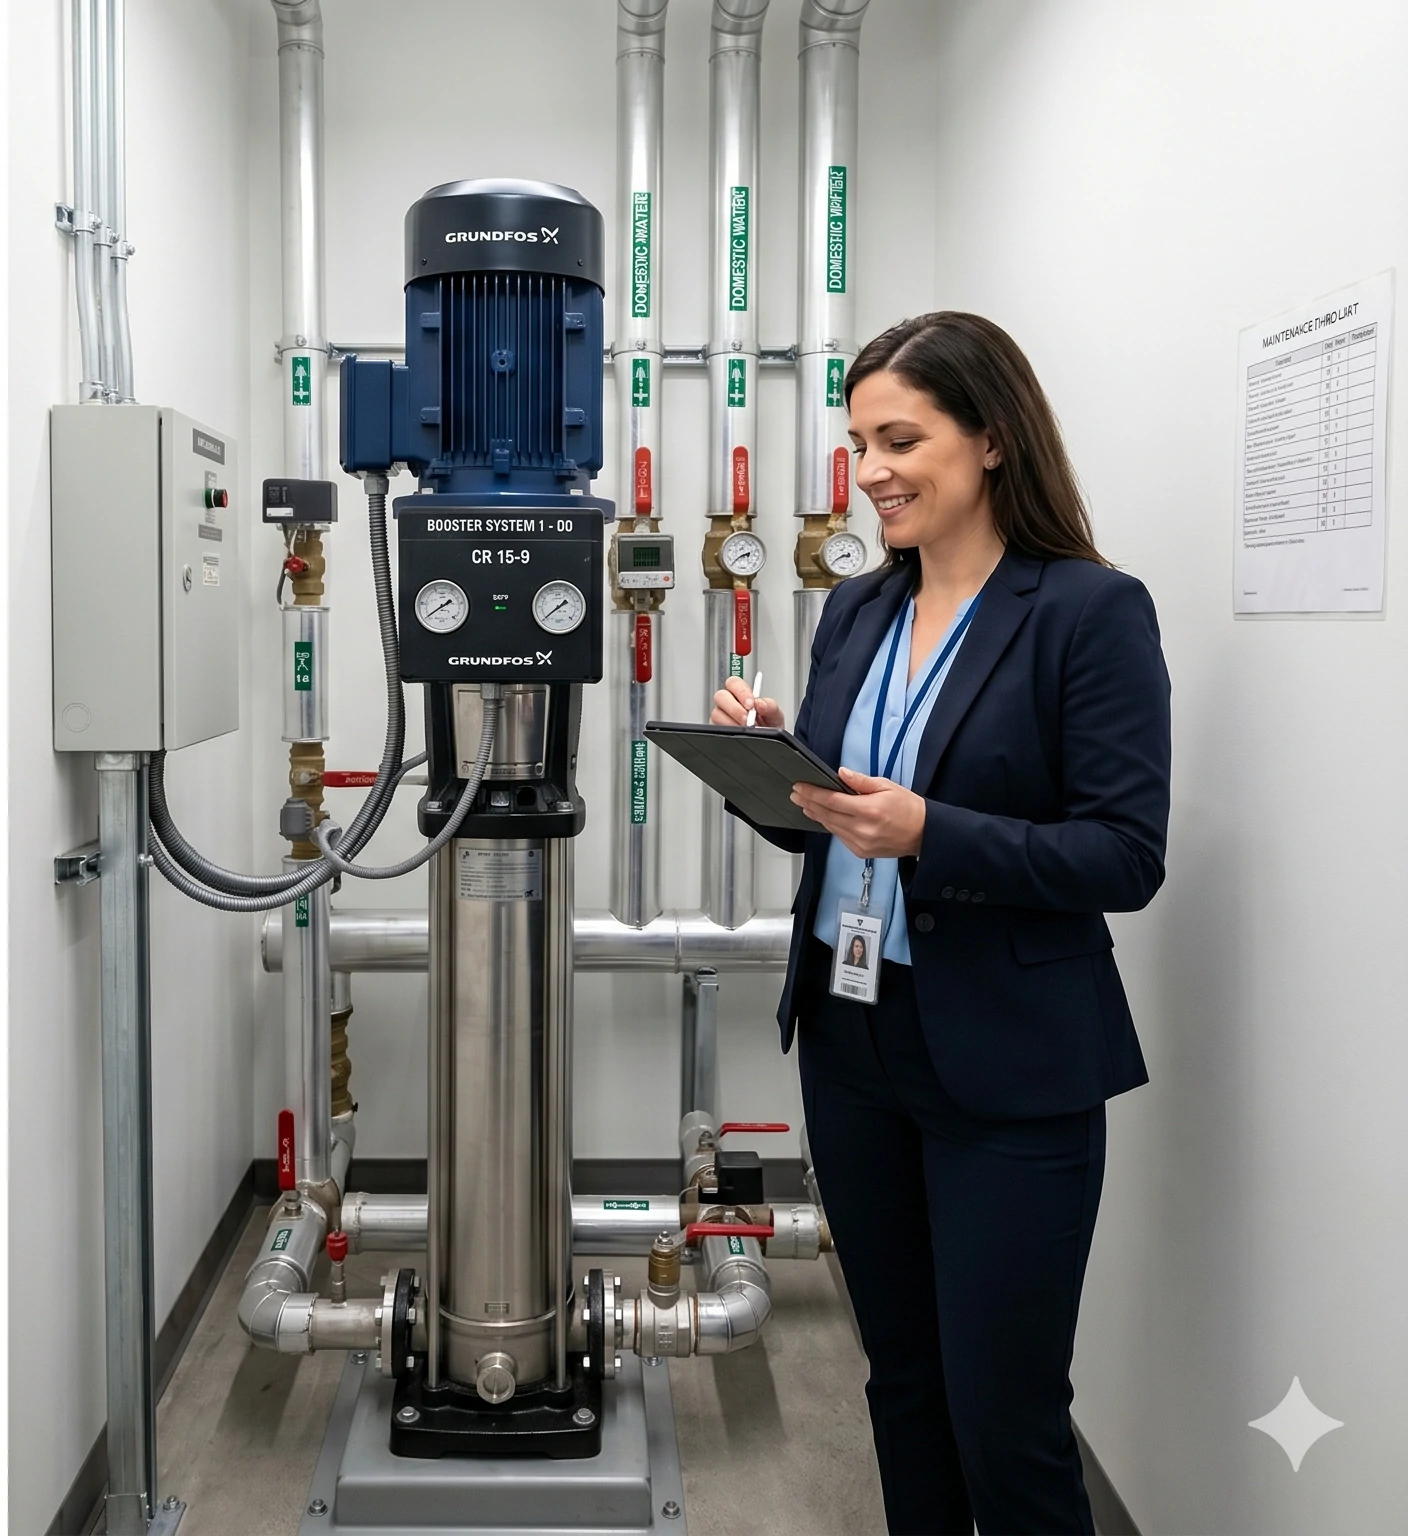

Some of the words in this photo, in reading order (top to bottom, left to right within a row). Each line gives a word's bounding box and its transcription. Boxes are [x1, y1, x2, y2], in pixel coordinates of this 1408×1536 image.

[445, 231, 538, 243] GRUNDFOS
[732, 239, 746, 307] DOMESTIC
[427, 518, 483, 532] BOOSTER
[485, 519, 535, 532] SYSTEM
[538, 519, 544, 532] 1
[471, 549, 493, 564] CR
[497, 549, 530, 564] 15-9
[448, 656, 534, 666] GRUNDFOS
